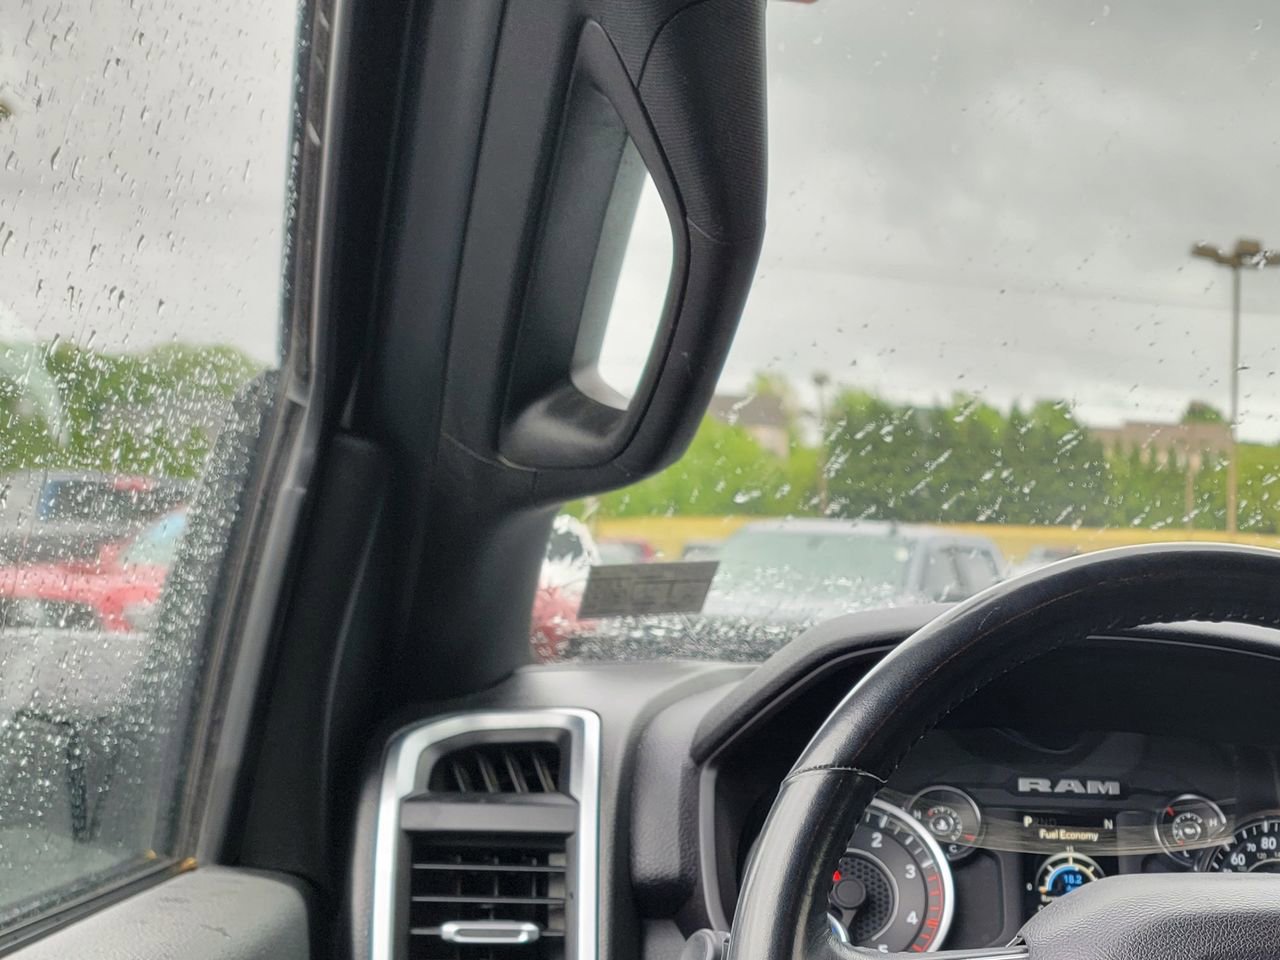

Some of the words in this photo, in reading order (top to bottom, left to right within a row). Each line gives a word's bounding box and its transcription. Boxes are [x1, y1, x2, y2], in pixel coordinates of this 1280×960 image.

[1018, 777, 1120, 795] RAM
[1103, 818, 1113, 830] N
[1209, 819, 1218, 828] H
[871, 833, 883, 848] 2
[1039, 829, 1059, 840] Fuel
[1060, 829, 1099, 842] Economy
[1247, 844, 1257, 853] 70
[1261, 837, 1277, 850] 80
[1231, 853, 1246, 866] 60
[905, 864, 916, 879] 3
[907, 911, 918, 925] 4
